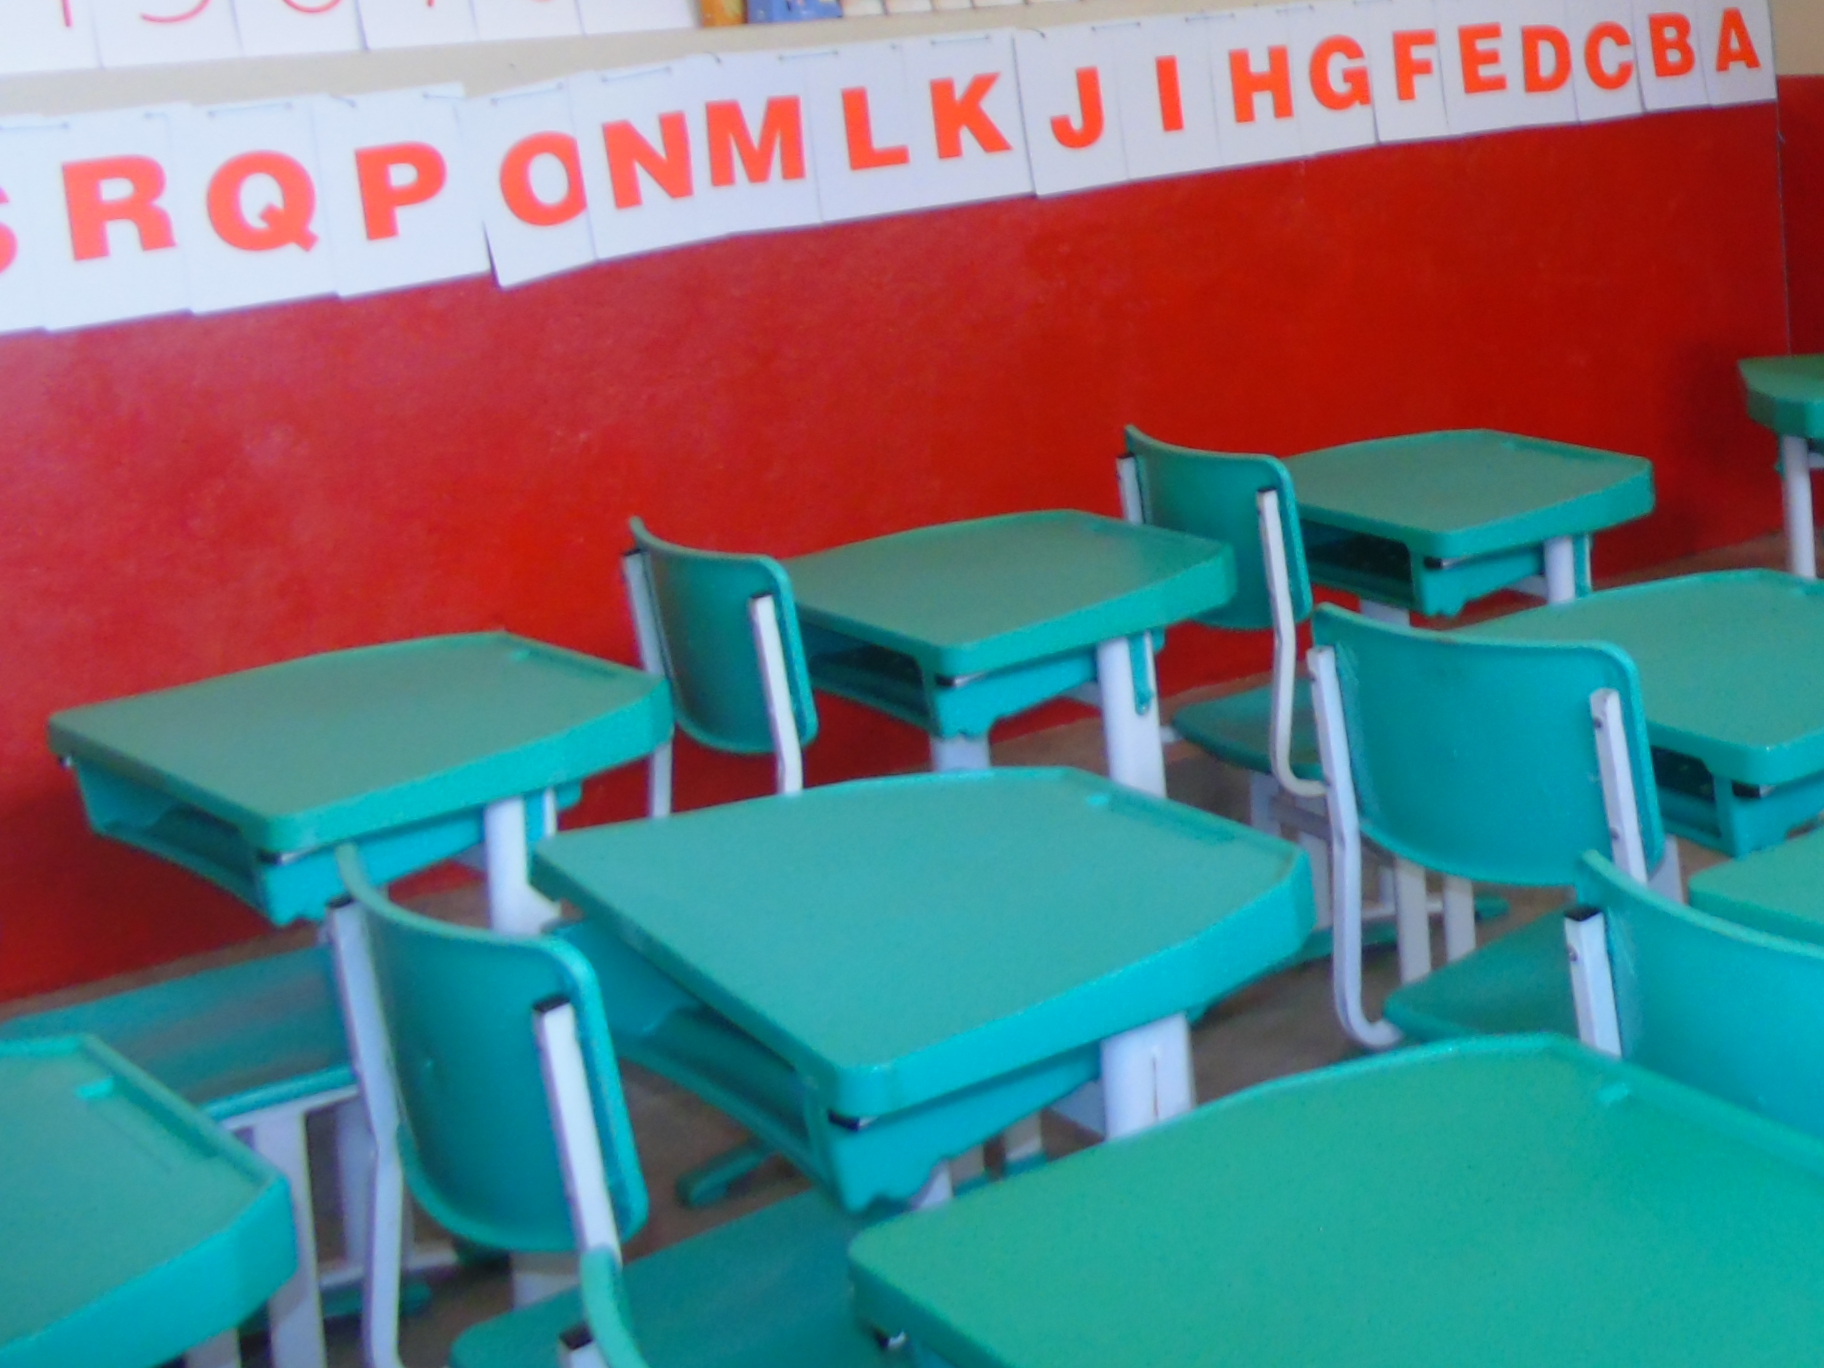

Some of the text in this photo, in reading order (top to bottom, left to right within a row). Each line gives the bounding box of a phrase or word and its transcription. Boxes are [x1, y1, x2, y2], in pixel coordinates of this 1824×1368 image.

[62, 155, 176, 262] R
[207, 150, 318, 254] Q
[354, 141, 448, 241] P
[499, 130, 588, 227] O
[601, 111, 693, 210] N
[704, 95, 806, 187] M
[841, 87, 910, 171] L
[929, 72, 1013, 159] K
[1050, 66, 1105, 150] J
[1155, 55, 1185, 133] I
[1228, 45, 1294, 124] H
[1308, 34, 1372, 111] G
[1392, 28, 1437, 102] F
[1457, 21, 1508, 95] E
[1521, 25, 1573, 94] D
[1584, 21, 1635, 91] C
[1648, 12, 1696, 78] B
[1716, 7, 1761, 72] A
